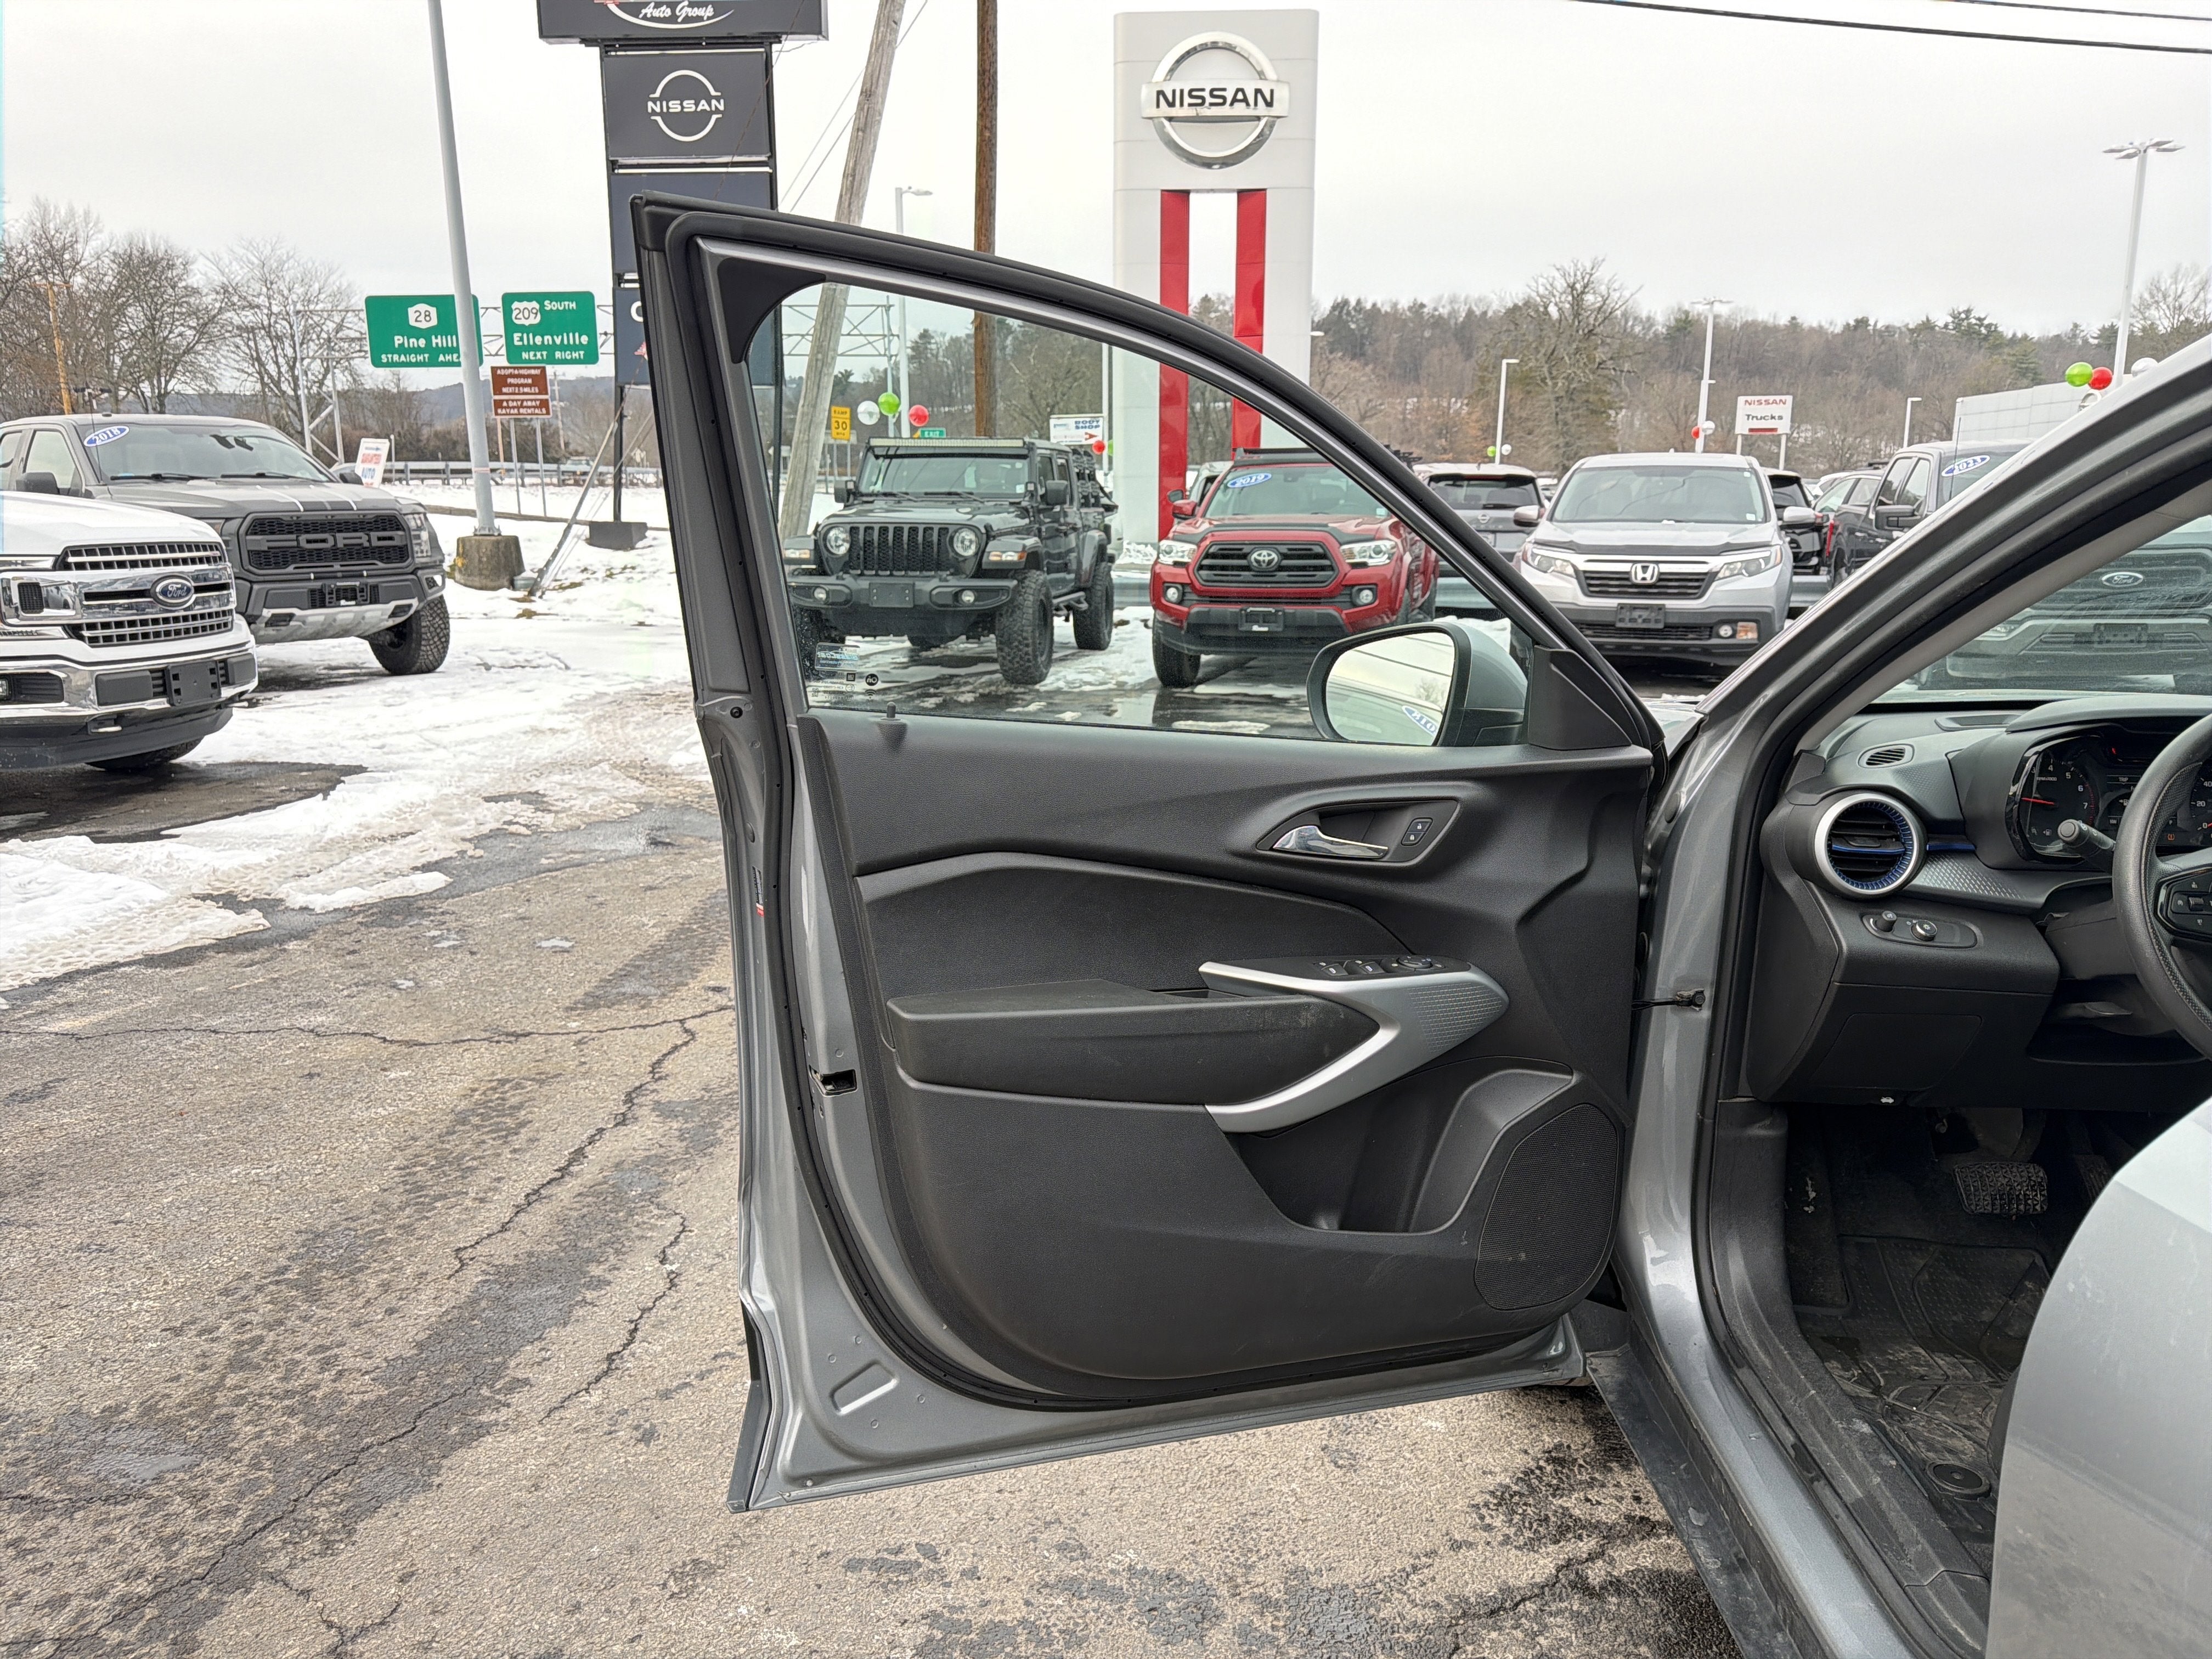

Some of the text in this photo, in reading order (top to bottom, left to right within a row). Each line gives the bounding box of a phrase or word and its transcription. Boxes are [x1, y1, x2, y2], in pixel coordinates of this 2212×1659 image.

[639, 1, 714, 22] Auto Group
[1155, 87, 1274, 109] NISSAN
[647, 99, 724, 113] NISSAN
[544, 300, 576, 311] SOUTH
[414, 309, 432, 323] 28
[514, 307, 539, 320] 209
[394, 335, 457, 348] Pine Hill
[513, 332, 589, 346] Ellenville
[381, 353, 461, 363] STRAIGHT AHE
[522, 351, 585, 360] NEXT RIGHT
[834, 420, 848, 431] 30
[92, 428, 121, 443] 2018
[246, 531, 407, 551] FORD
[2112, 575, 2134, 584] Ford
[167, 584, 187, 597] Ford
